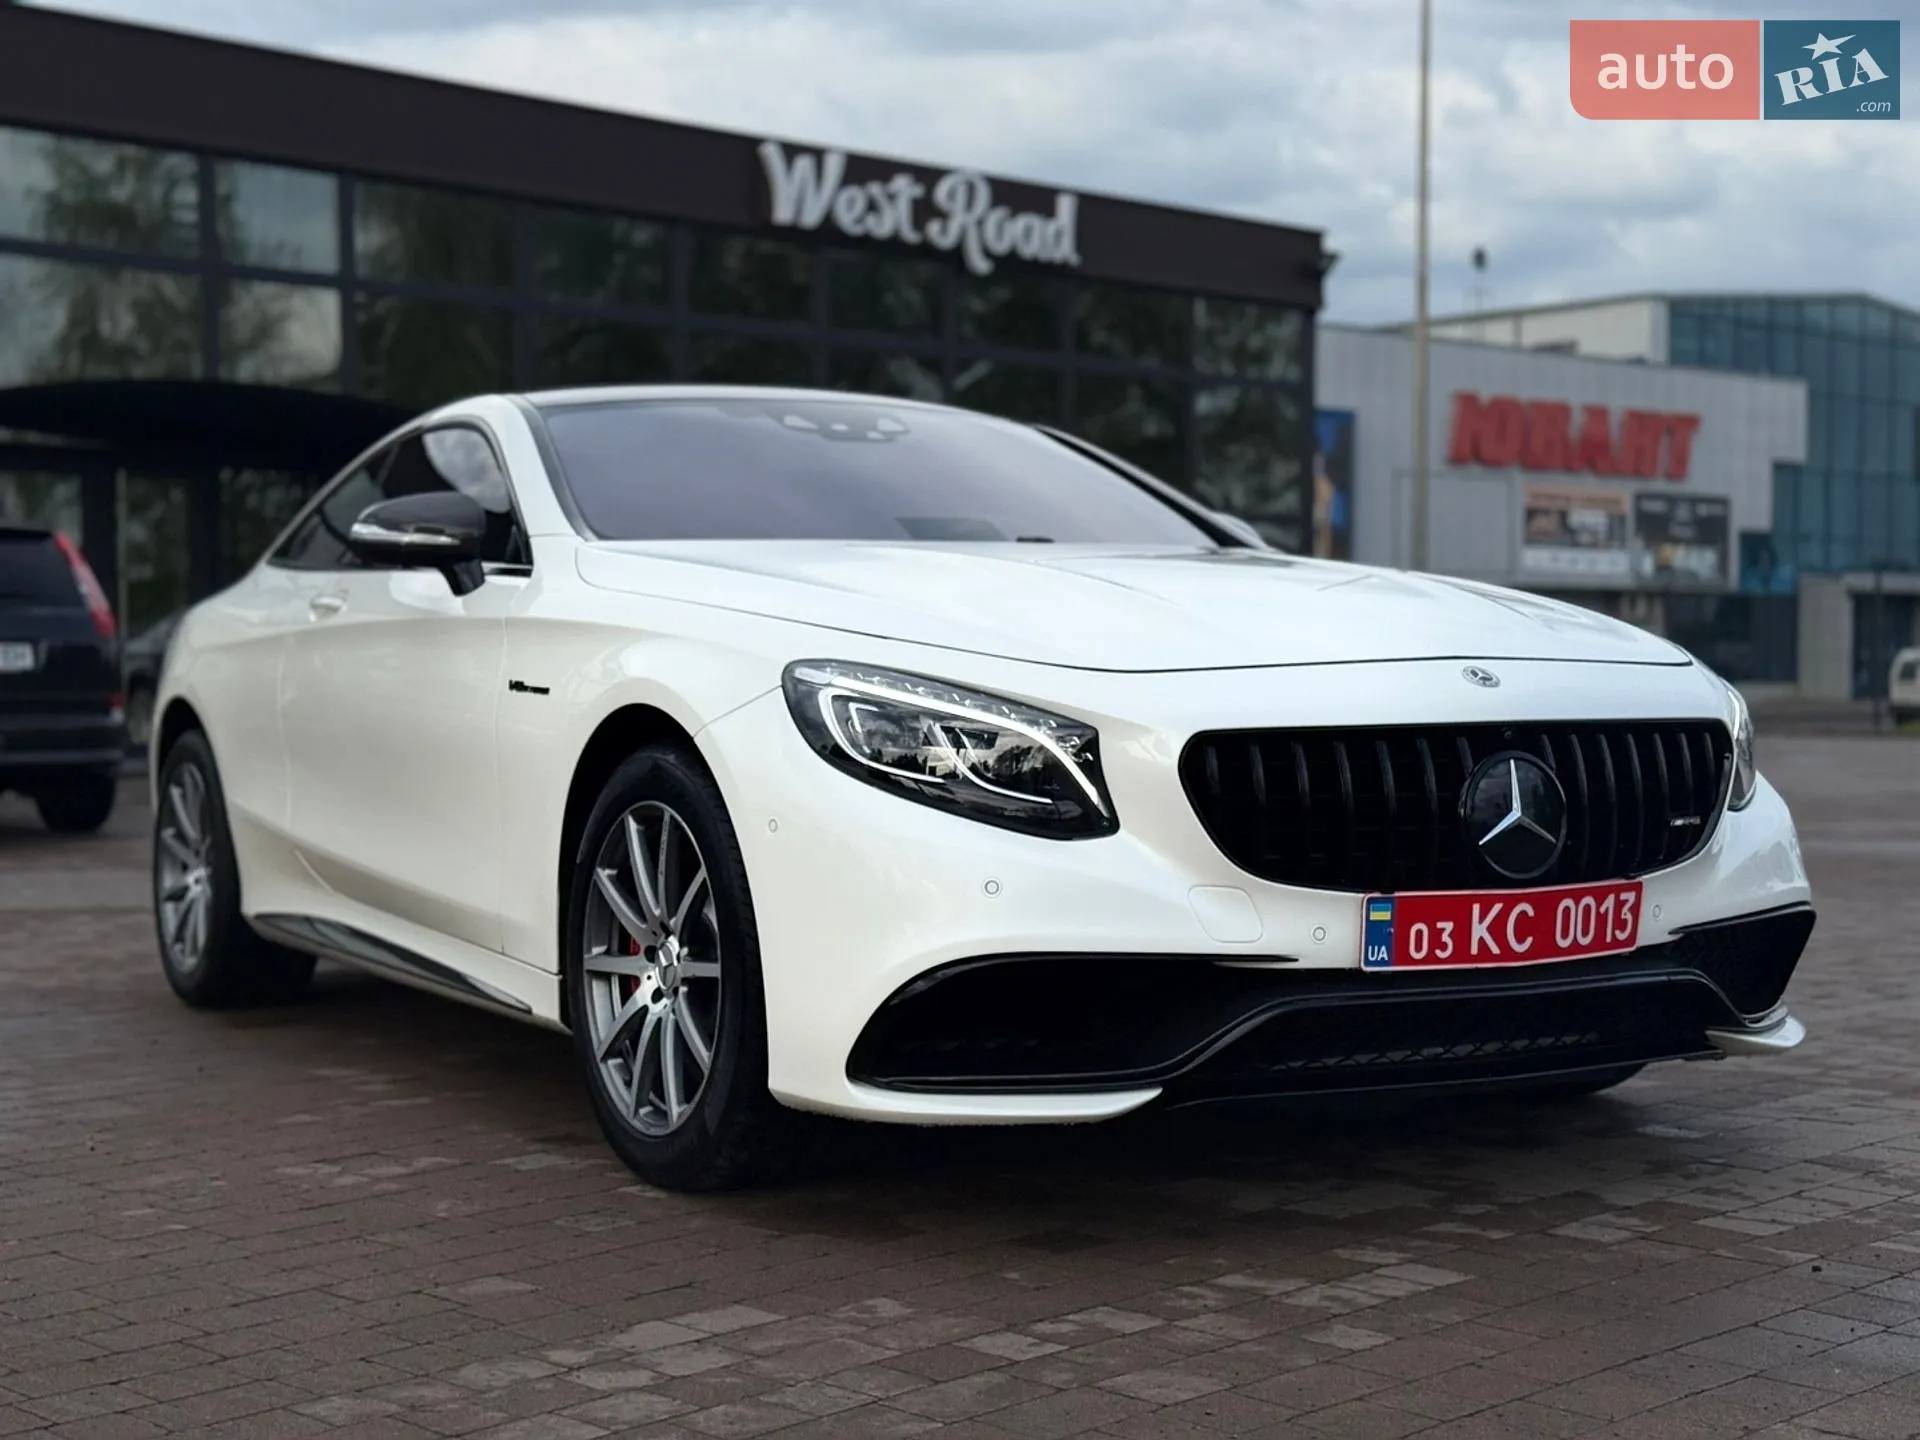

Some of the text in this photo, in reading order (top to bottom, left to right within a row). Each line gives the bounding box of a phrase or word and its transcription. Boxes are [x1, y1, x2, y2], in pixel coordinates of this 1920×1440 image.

[758, 141, 1081, 276] West Road
[1367, 945, 1389, 961] UA
[1408, 891, 1636, 960] 03 KC 0013
